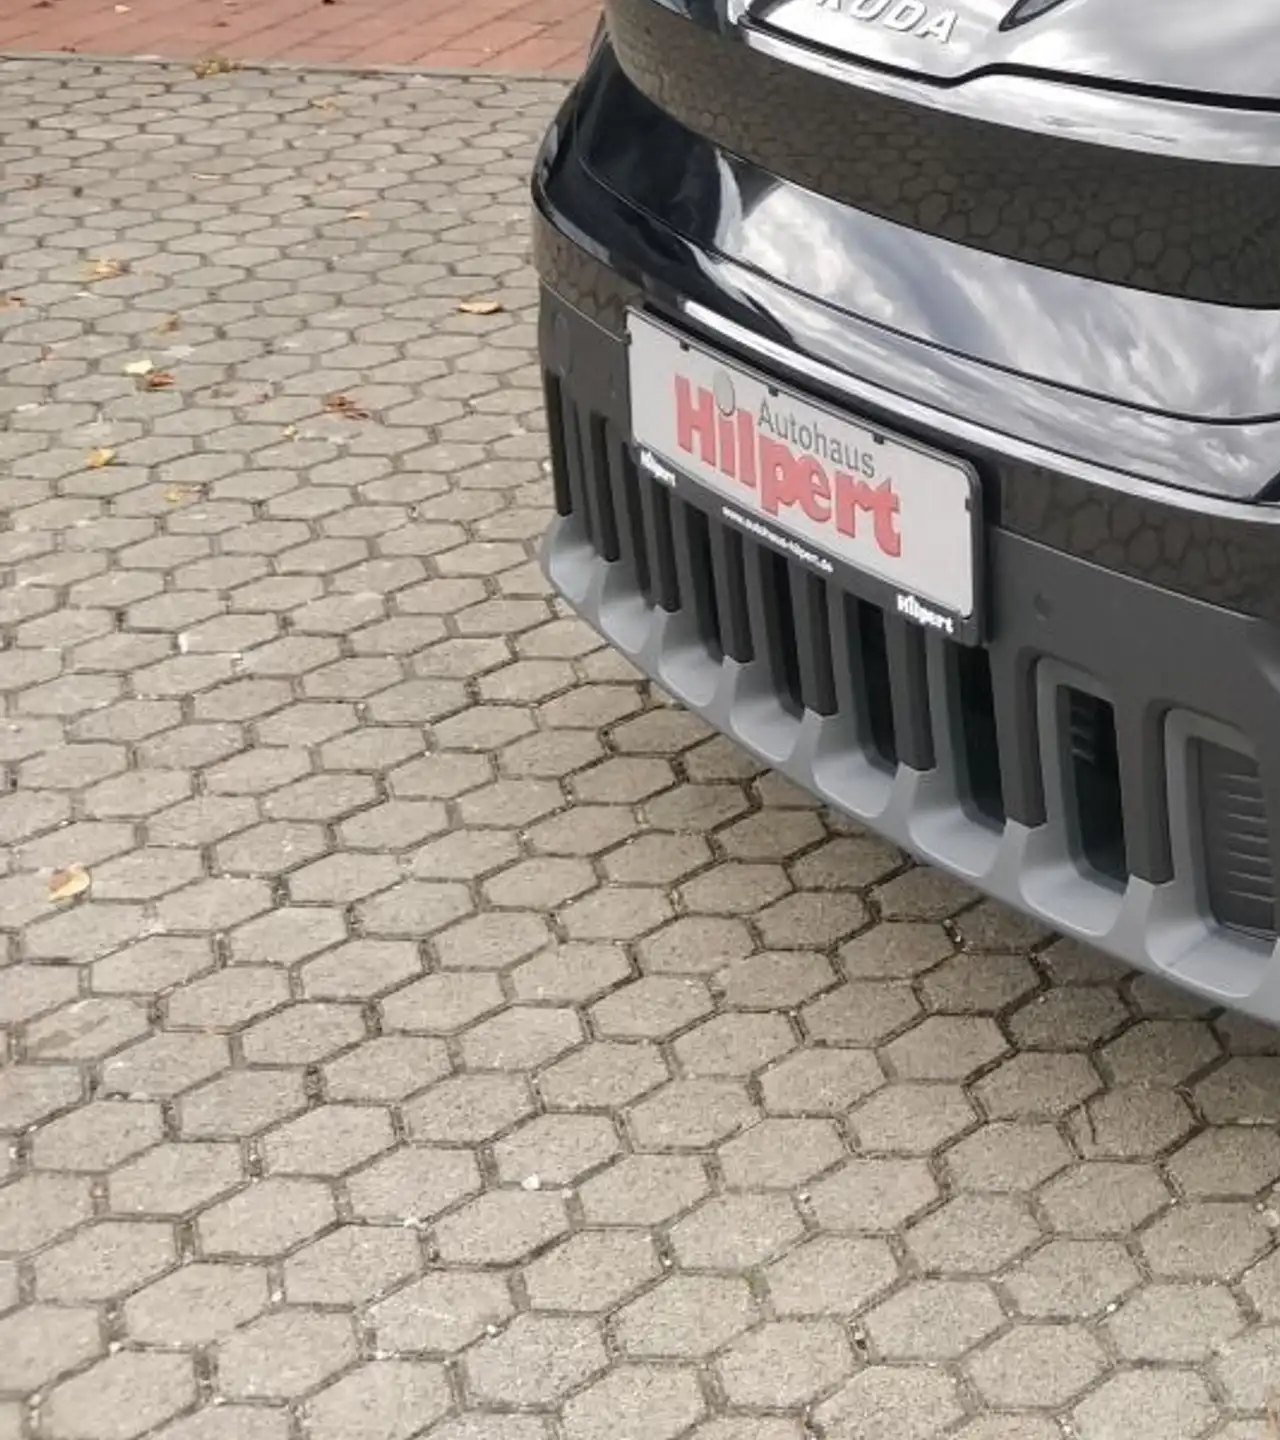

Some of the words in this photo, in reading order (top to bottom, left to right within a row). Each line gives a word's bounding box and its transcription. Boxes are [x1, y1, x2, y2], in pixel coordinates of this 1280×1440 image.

[675, 368, 901, 558] Hilpert
[758, 397, 875, 479] Autohaus
[897, 592, 954, 634] Hilpert
